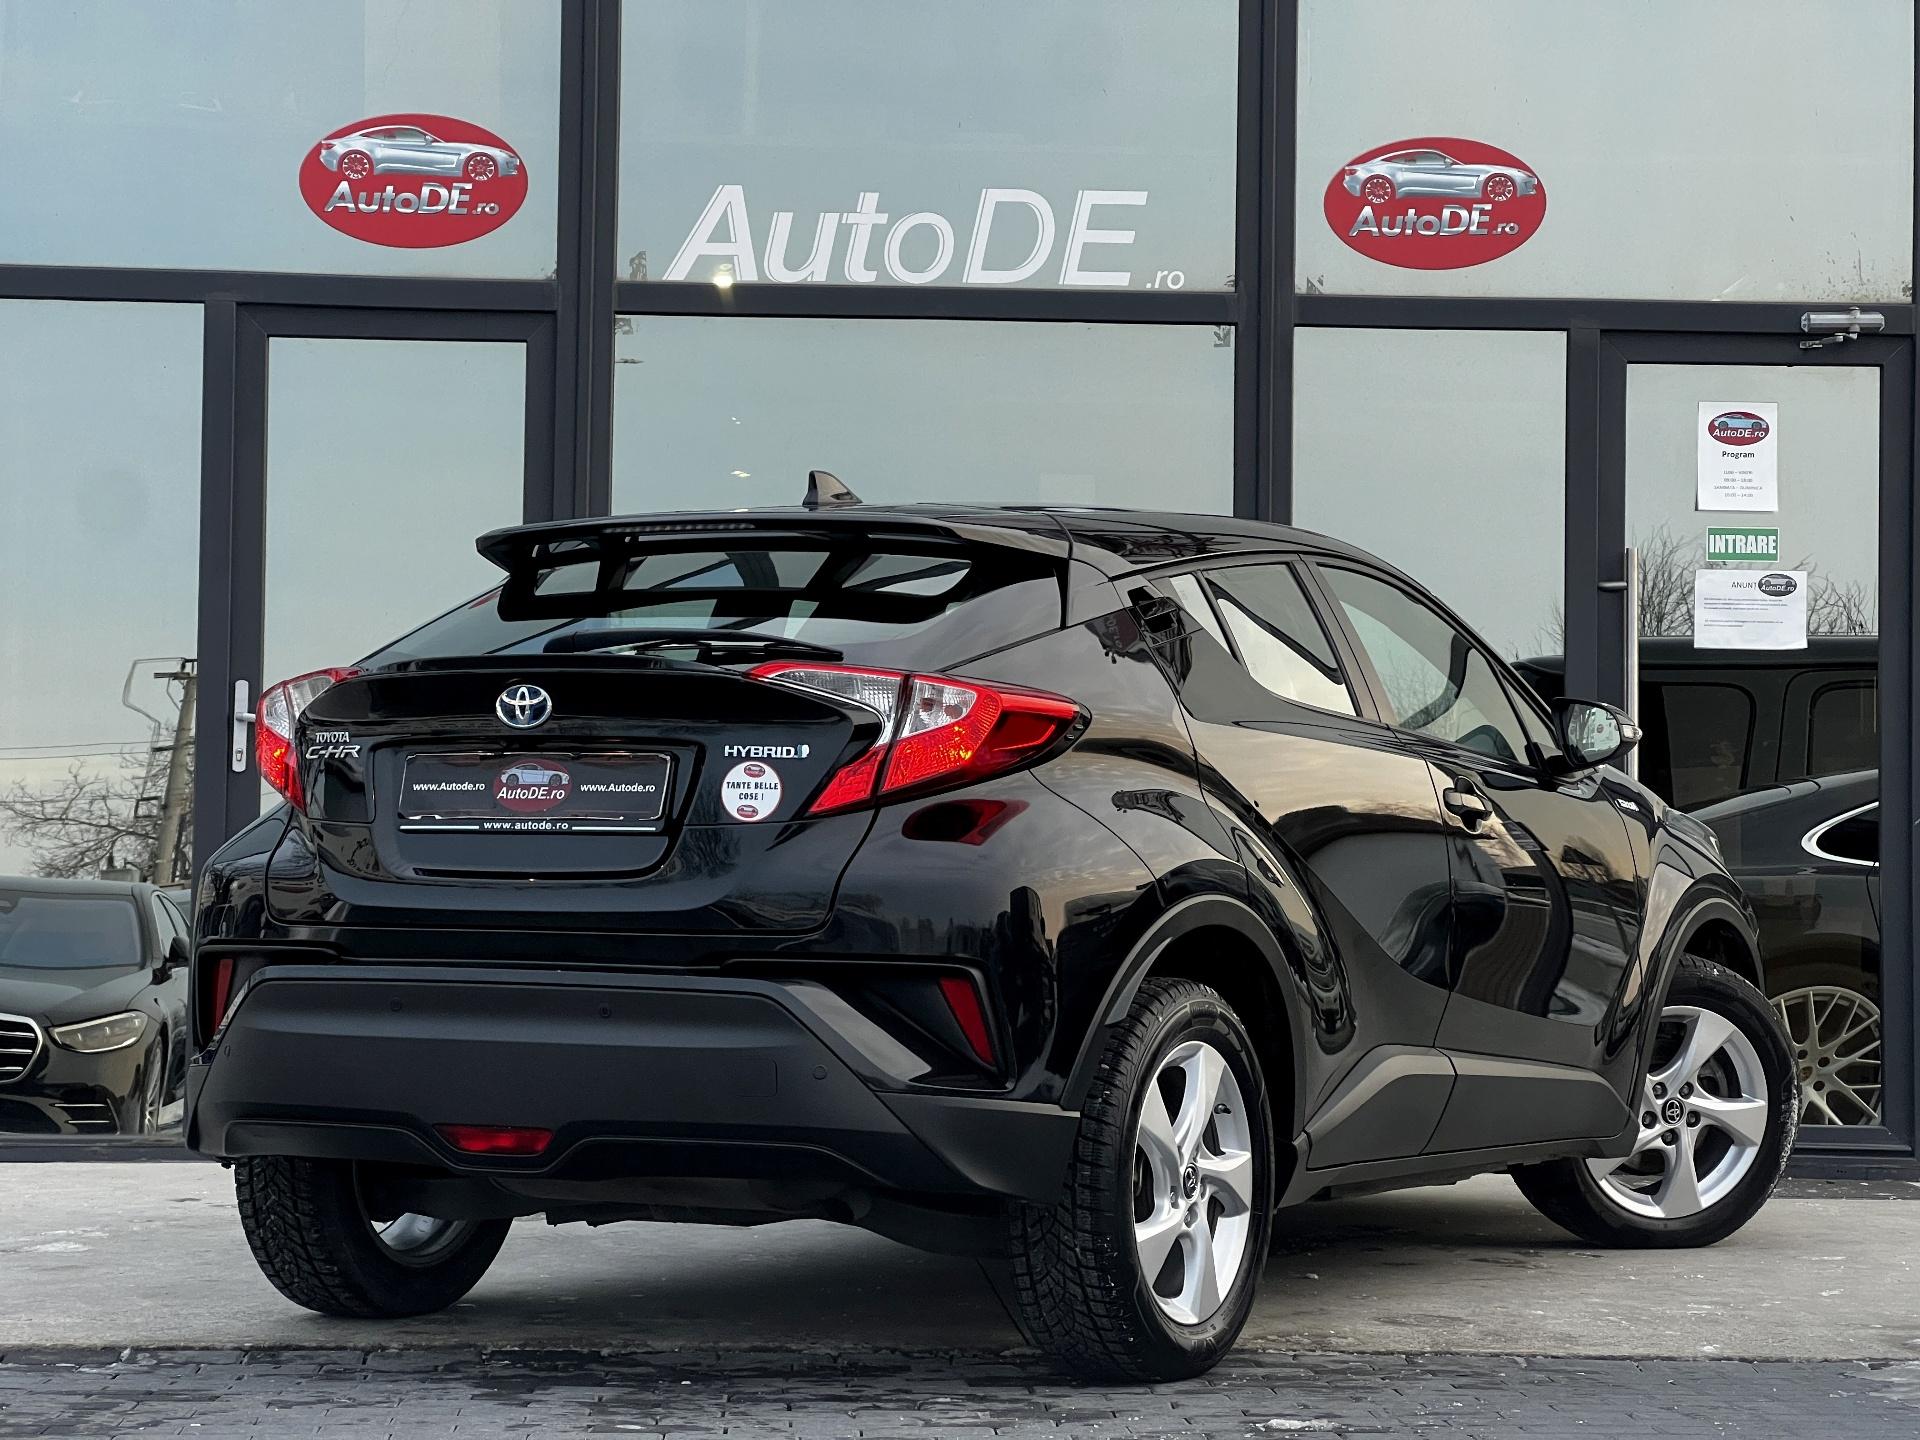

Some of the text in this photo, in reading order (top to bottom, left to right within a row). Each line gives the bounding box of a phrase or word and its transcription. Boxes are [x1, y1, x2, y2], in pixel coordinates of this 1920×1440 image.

[1712, 428, 1766, 438] AutoDE.ro
[1721, 450, 1755, 459] Program
[1708, 534, 1777, 554] INTRARE
[315, 731, 350, 743] TOYOTA
[305, 745, 361, 759] C-HR
[724, 745, 796, 758] HYBRID
[412, 781, 486, 791] www.Autode.ro
[580, 782, 656, 793] www.Autode.ro
[726, 781, 779, 790] TANTE BELLE
[496, 786, 566, 800] AutoDE.ro
[738, 792, 759, 801] COSE
[483, 820, 569, 830] www.autode.ro
